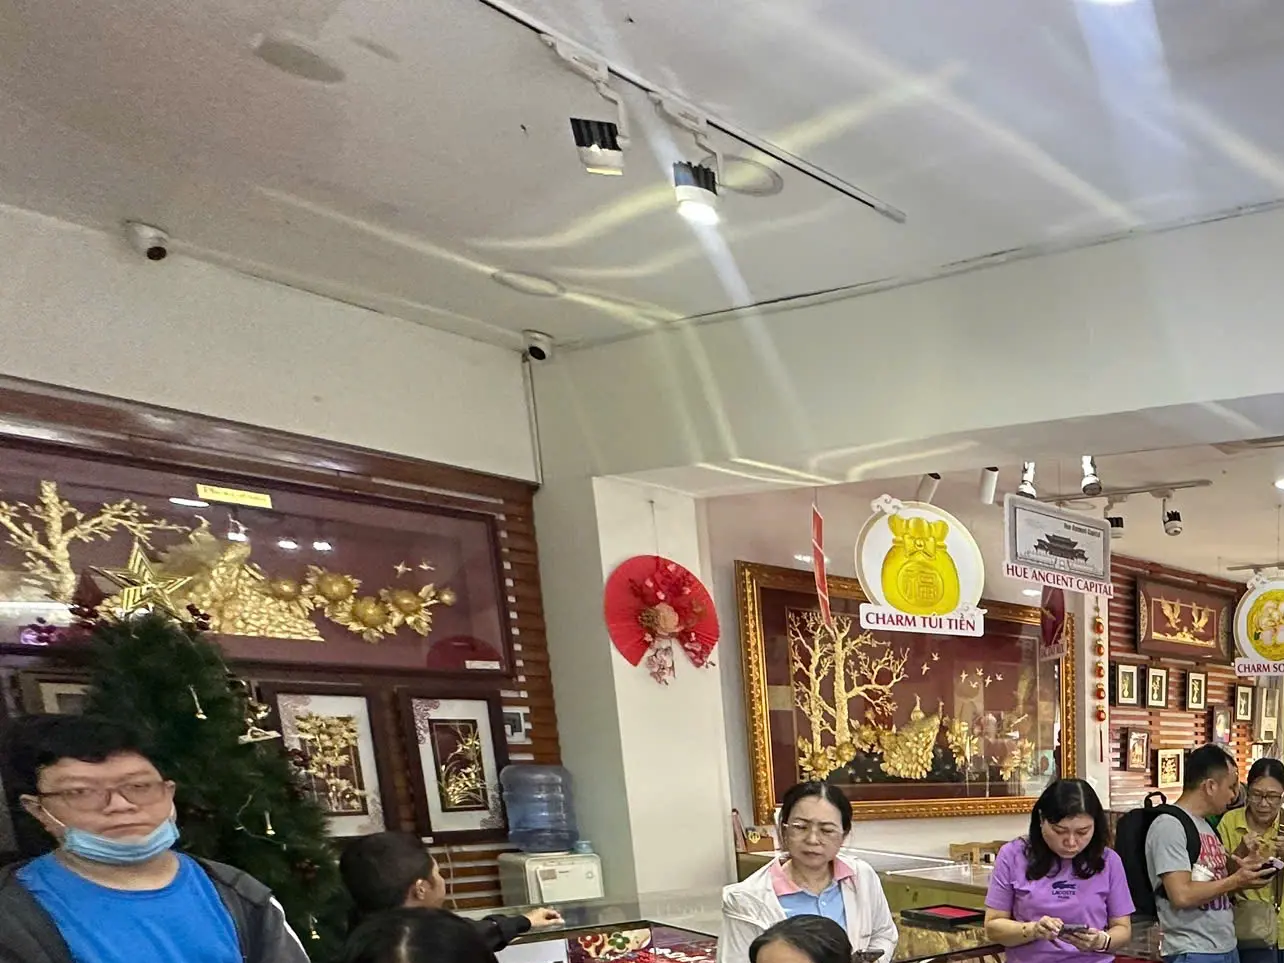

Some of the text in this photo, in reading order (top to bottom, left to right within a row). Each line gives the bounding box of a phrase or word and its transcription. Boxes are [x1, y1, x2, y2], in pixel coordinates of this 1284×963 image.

[1006, 563, 1113, 597] HUE ANCIENT CAPITAL
[865, 612, 917, 628] CHARM
[921, 613, 942, 629] TÚI
[1237, 662, 1271, 673] CHARM
